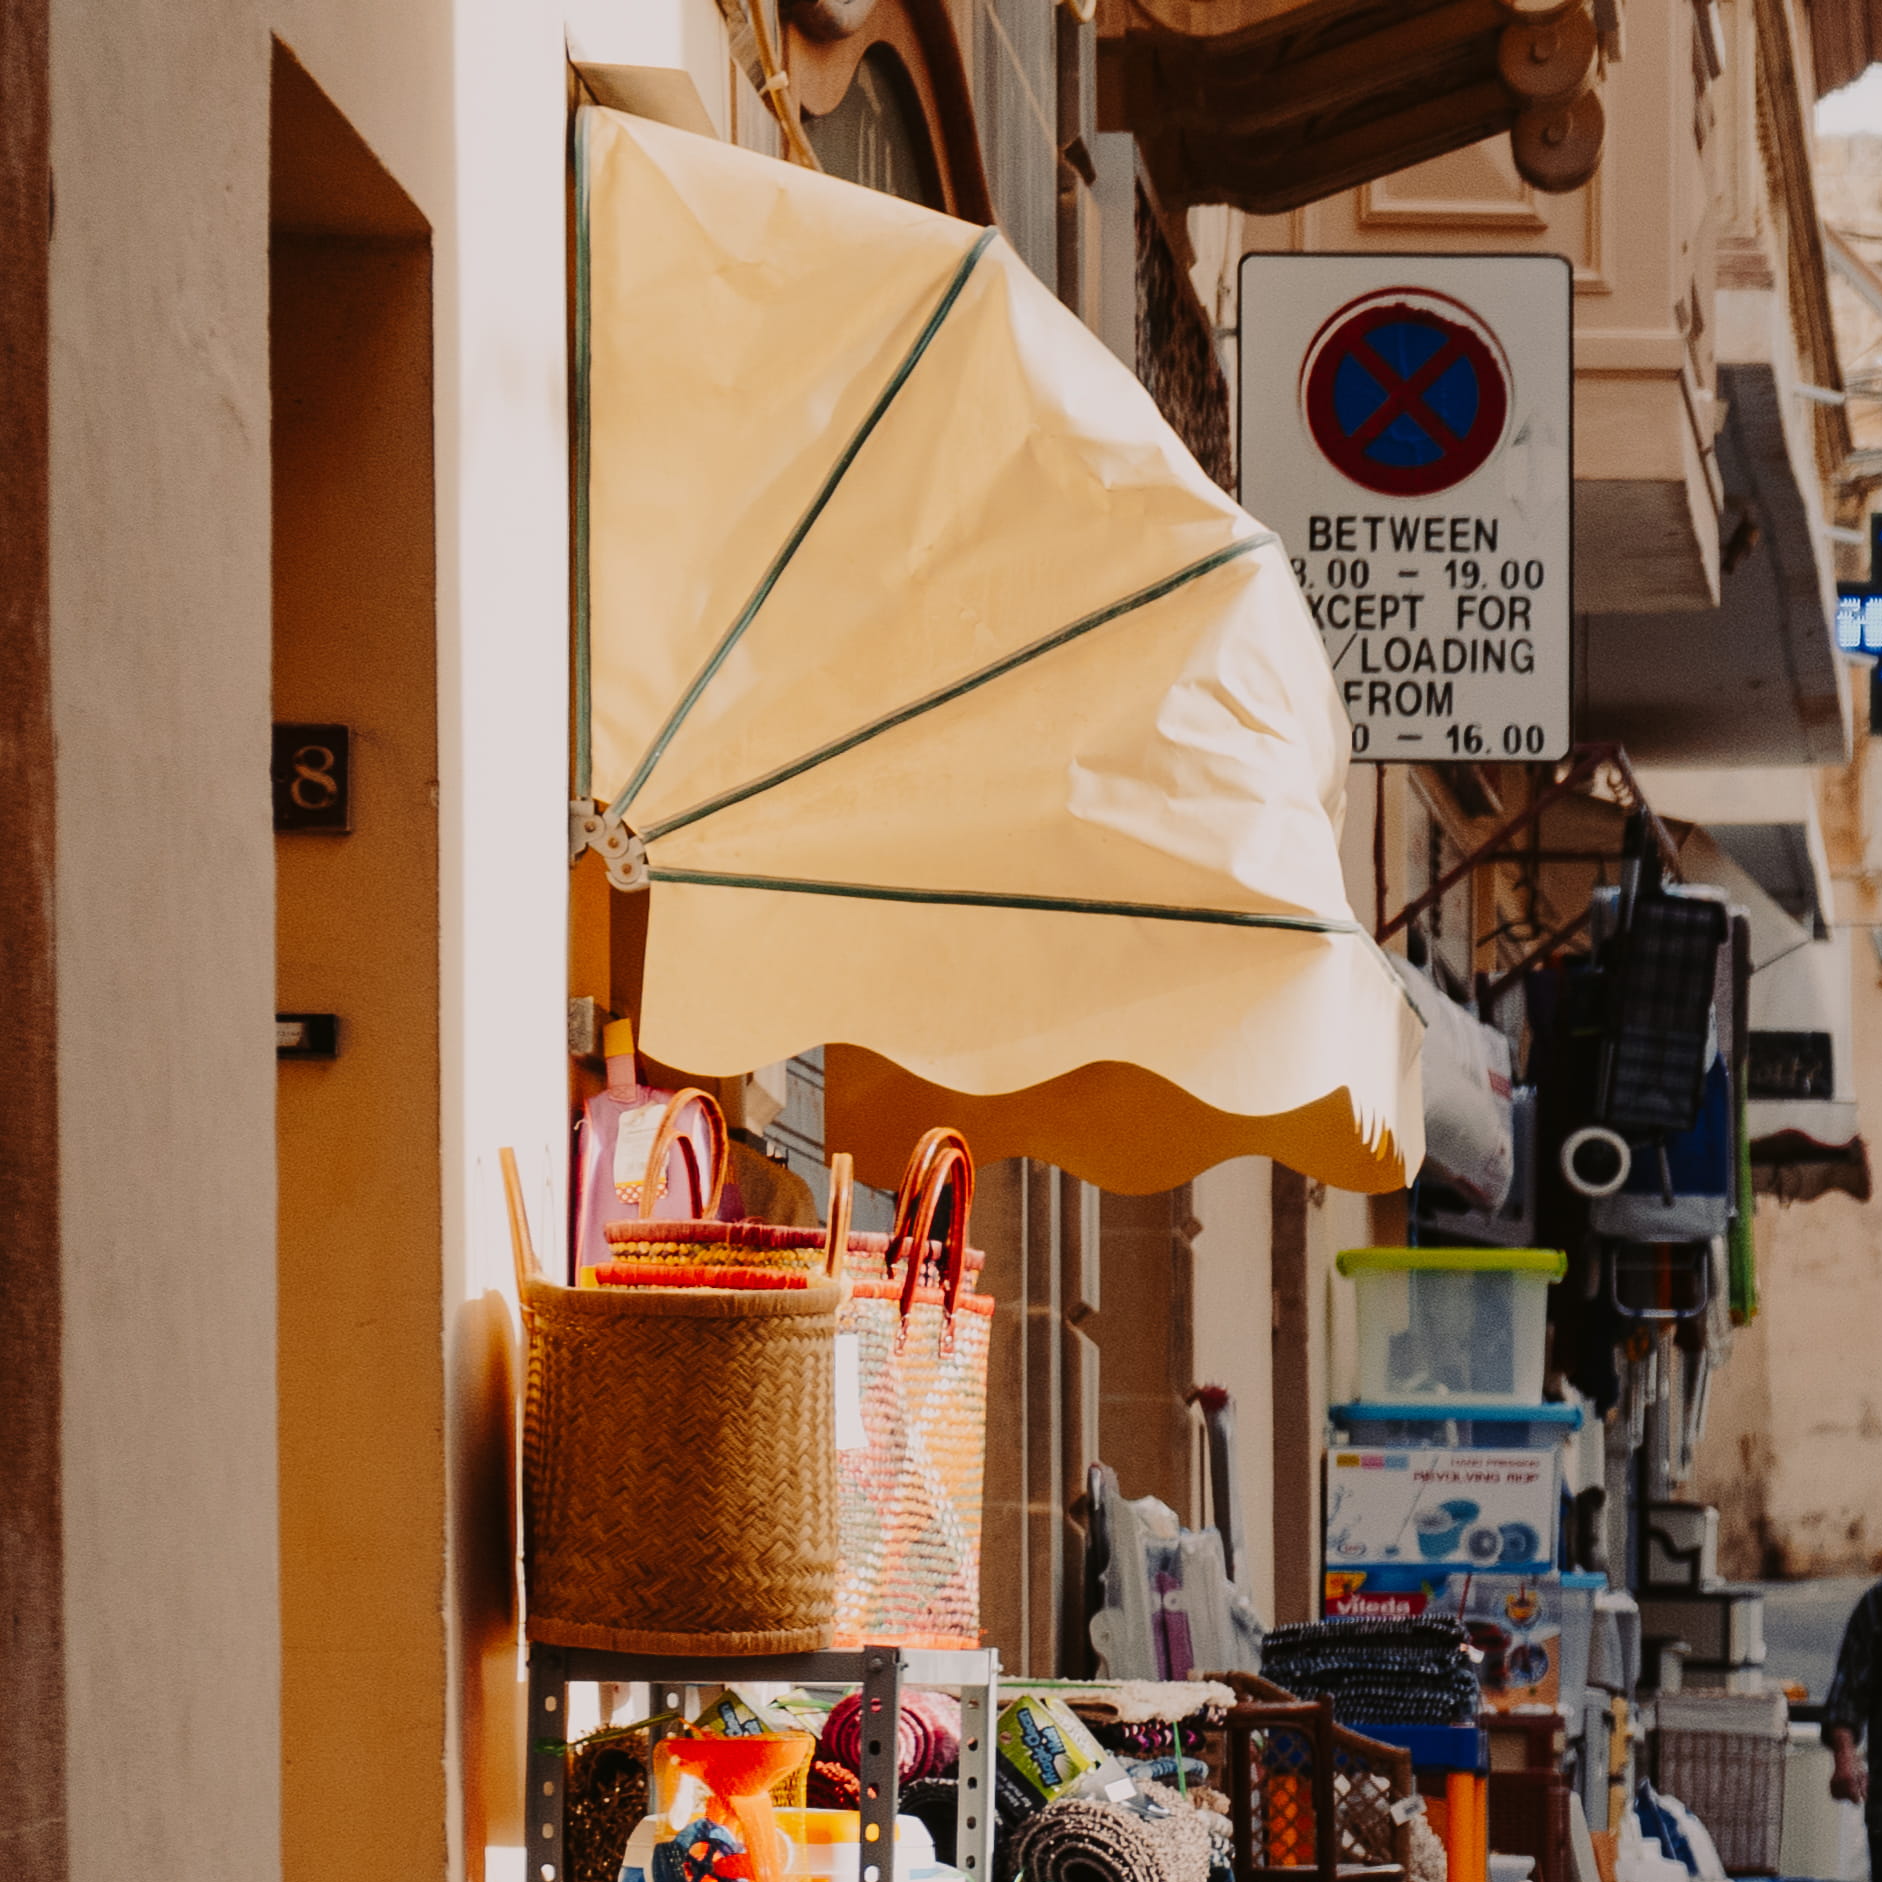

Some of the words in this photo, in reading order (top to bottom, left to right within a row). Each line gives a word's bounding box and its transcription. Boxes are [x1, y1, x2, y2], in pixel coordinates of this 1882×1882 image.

[1309, 515, 1498, 553] BETWEEN
[1445, 558, 1544, 591] 19.00
[1306, 593, 1425, 631] XCEPT
[1457, 594, 1532, 632] FOR
[1323, 633, 1535, 675] /LOADING
[1344, 680, 1453, 717] FROM
[1446, 722, 1545, 755] 16.00
[290, 744, 338, 811] 8
